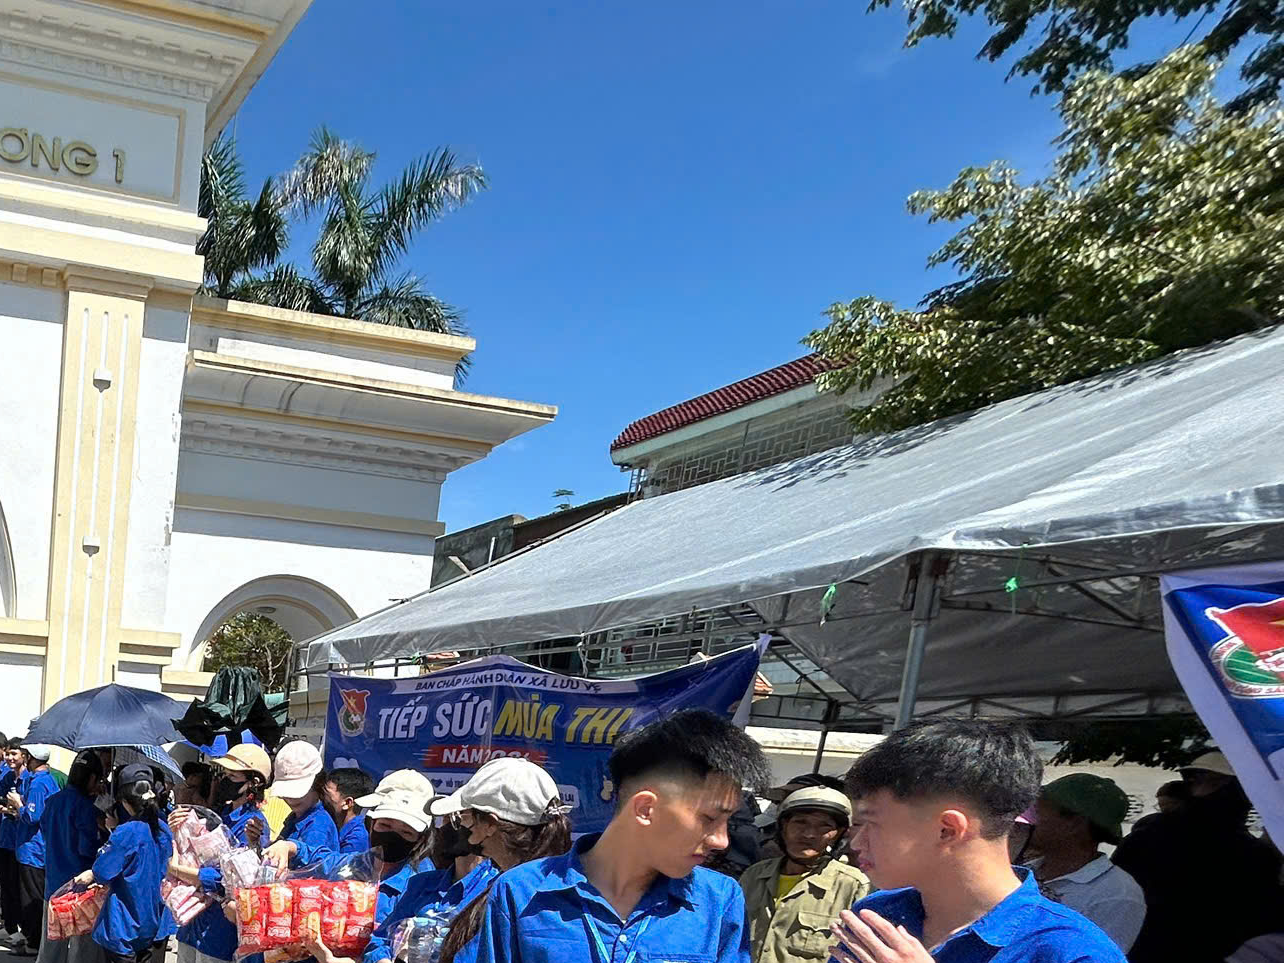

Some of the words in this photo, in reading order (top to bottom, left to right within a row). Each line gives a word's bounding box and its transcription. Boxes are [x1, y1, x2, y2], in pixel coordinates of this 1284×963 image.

[113, 147, 126, 184] 1
[416, 681, 435, 691] BAN
[529, 675, 547, 687] XÃ
[378, 695, 428, 739] TIẾP
[432, 692, 491, 739] SỨC
[493, 693, 561, 742] MÙA
[566, 706, 634, 745] THI
[442, 744, 484, 764] NĂM
